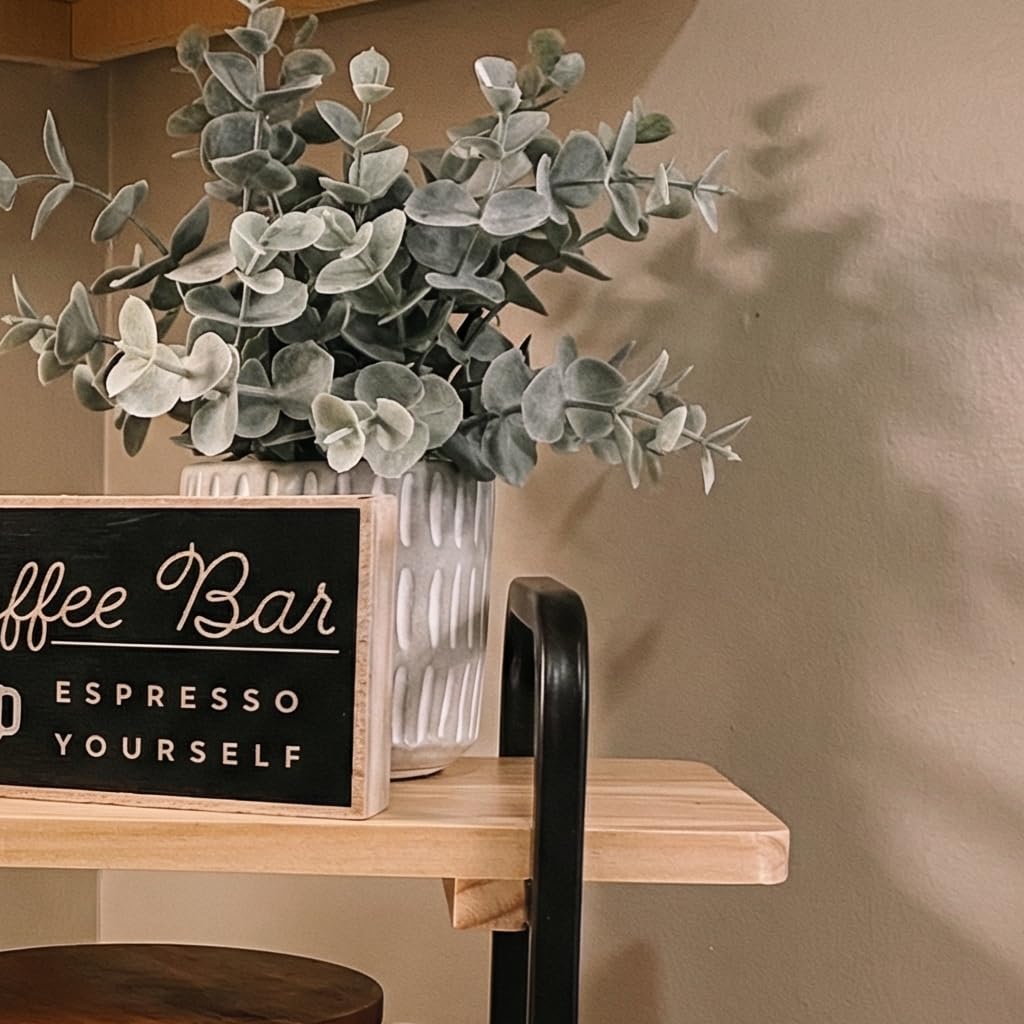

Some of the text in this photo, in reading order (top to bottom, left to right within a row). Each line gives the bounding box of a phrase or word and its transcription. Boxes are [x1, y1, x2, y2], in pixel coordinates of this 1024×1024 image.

[156, 542, 336, 639] Bar
[56, 680, 299, 713] ESPRESSO
[54, 732, 301, 768] YOURSELF
